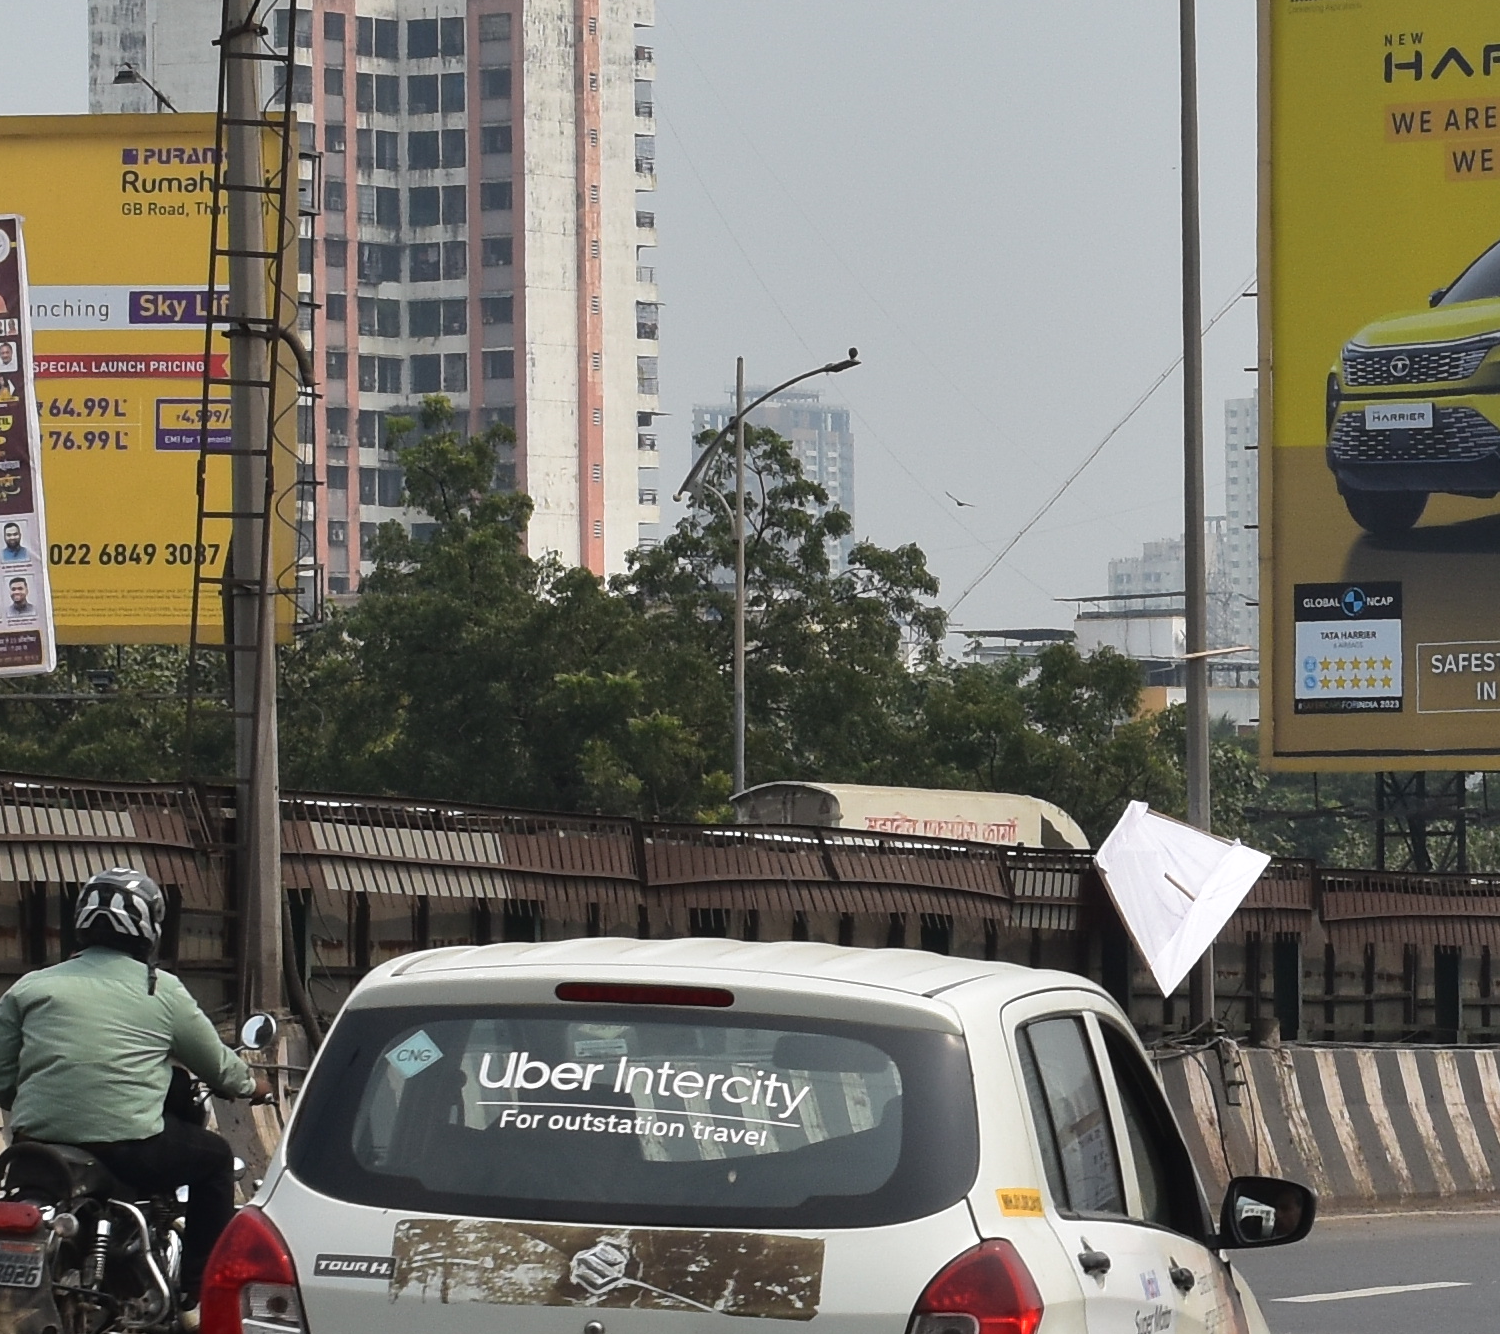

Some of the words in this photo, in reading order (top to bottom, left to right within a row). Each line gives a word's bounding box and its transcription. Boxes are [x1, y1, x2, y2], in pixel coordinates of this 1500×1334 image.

[1384, 32, 1423, 47] NEW
[1392, 112, 1432, 135] WE
[1444, 106, 1497, 132] ARE
[1452, 150, 1492, 173] WE
[122, 170, 214, 193] Rumah
[122, 203, 143, 216] GB
[148, 202, 190, 217] Road,
[139, 294, 187, 322] Sky
[33, 361, 87, 373] SPECIAL
[91, 361, 145, 373] LAUNCH
[150, 360, 205, 373] PRICING
[49, 398, 110, 417] 64.99
[1372, 412, 1426, 422] HARRIER
[49, 431, 110, 451] 76.99
[50, 544, 91, 565] 022
[98, 543, 157, 565] 6849
[1303, 598, 1340, 608] GLOBAL
[1366, 596, 1394, 606] NCAP
[1320, 631, 1340, 640] TATA
[1341, 630, 1377, 639] HARRIER
[1476, 682, 1498, 701] IN
[396, 1048, 432, 1063] CNG
[477, 1051, 605, 1091] Uber
[613, 1056, 810, 1120] Intercity
[500, 1109, 545, 1129] For
[547, 1112, 685, 1139] outstation
[693, 1122, 768, 1147] travel
[317, 1260, 368, 1272] TOUR
